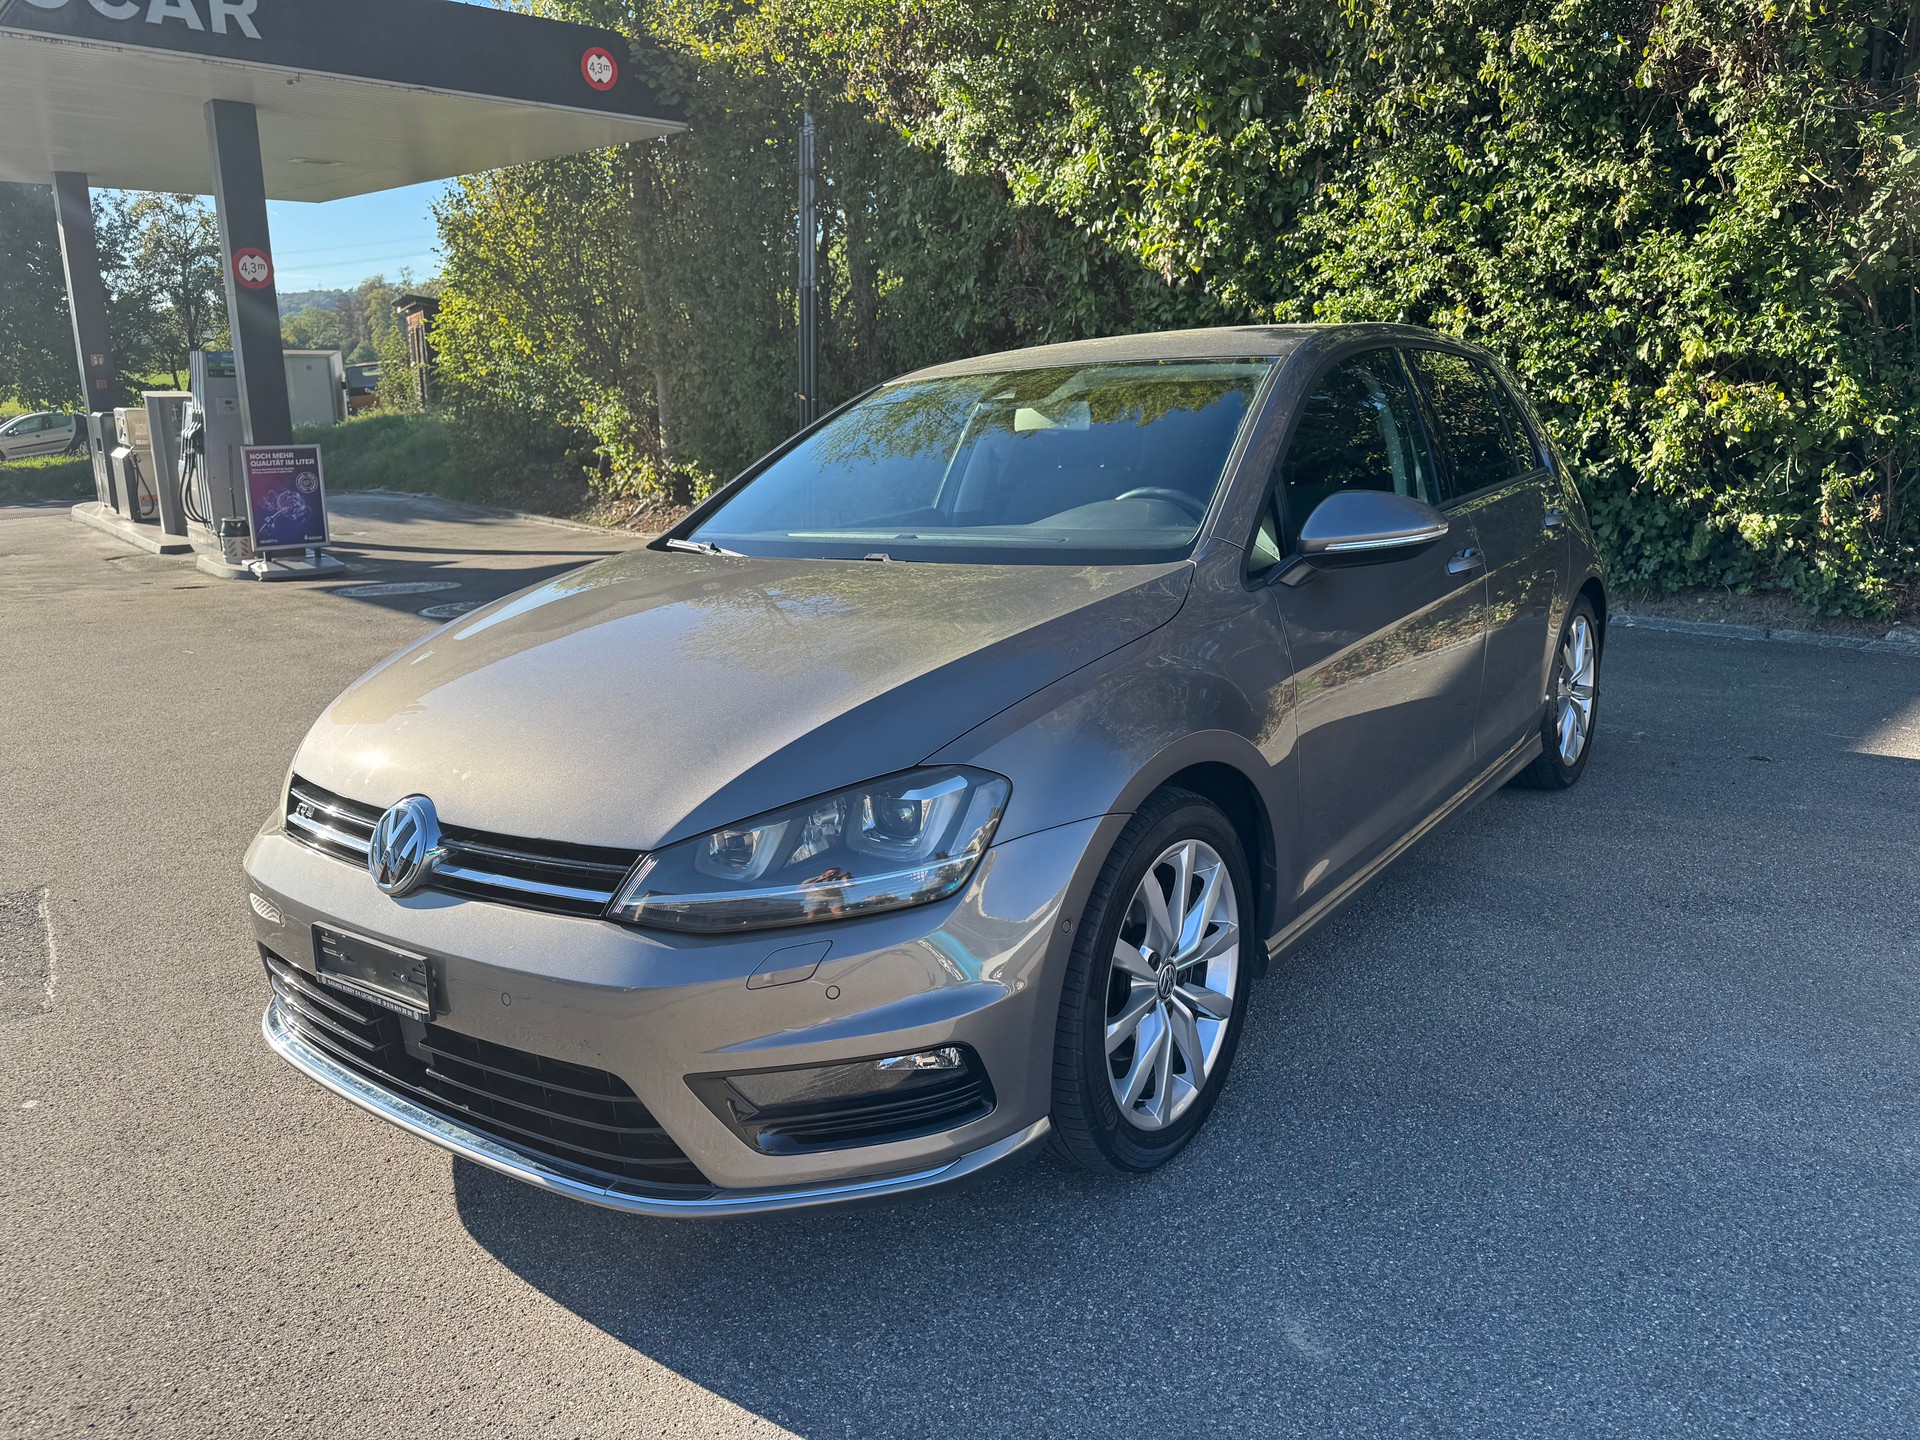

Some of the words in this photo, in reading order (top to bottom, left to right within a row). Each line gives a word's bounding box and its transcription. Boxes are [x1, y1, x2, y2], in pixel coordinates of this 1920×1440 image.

[249, 452, 271, 460] NOCH
[272, 451, 294, 459] MEHR
[250, 459, 285, 467] QUALITÄT
